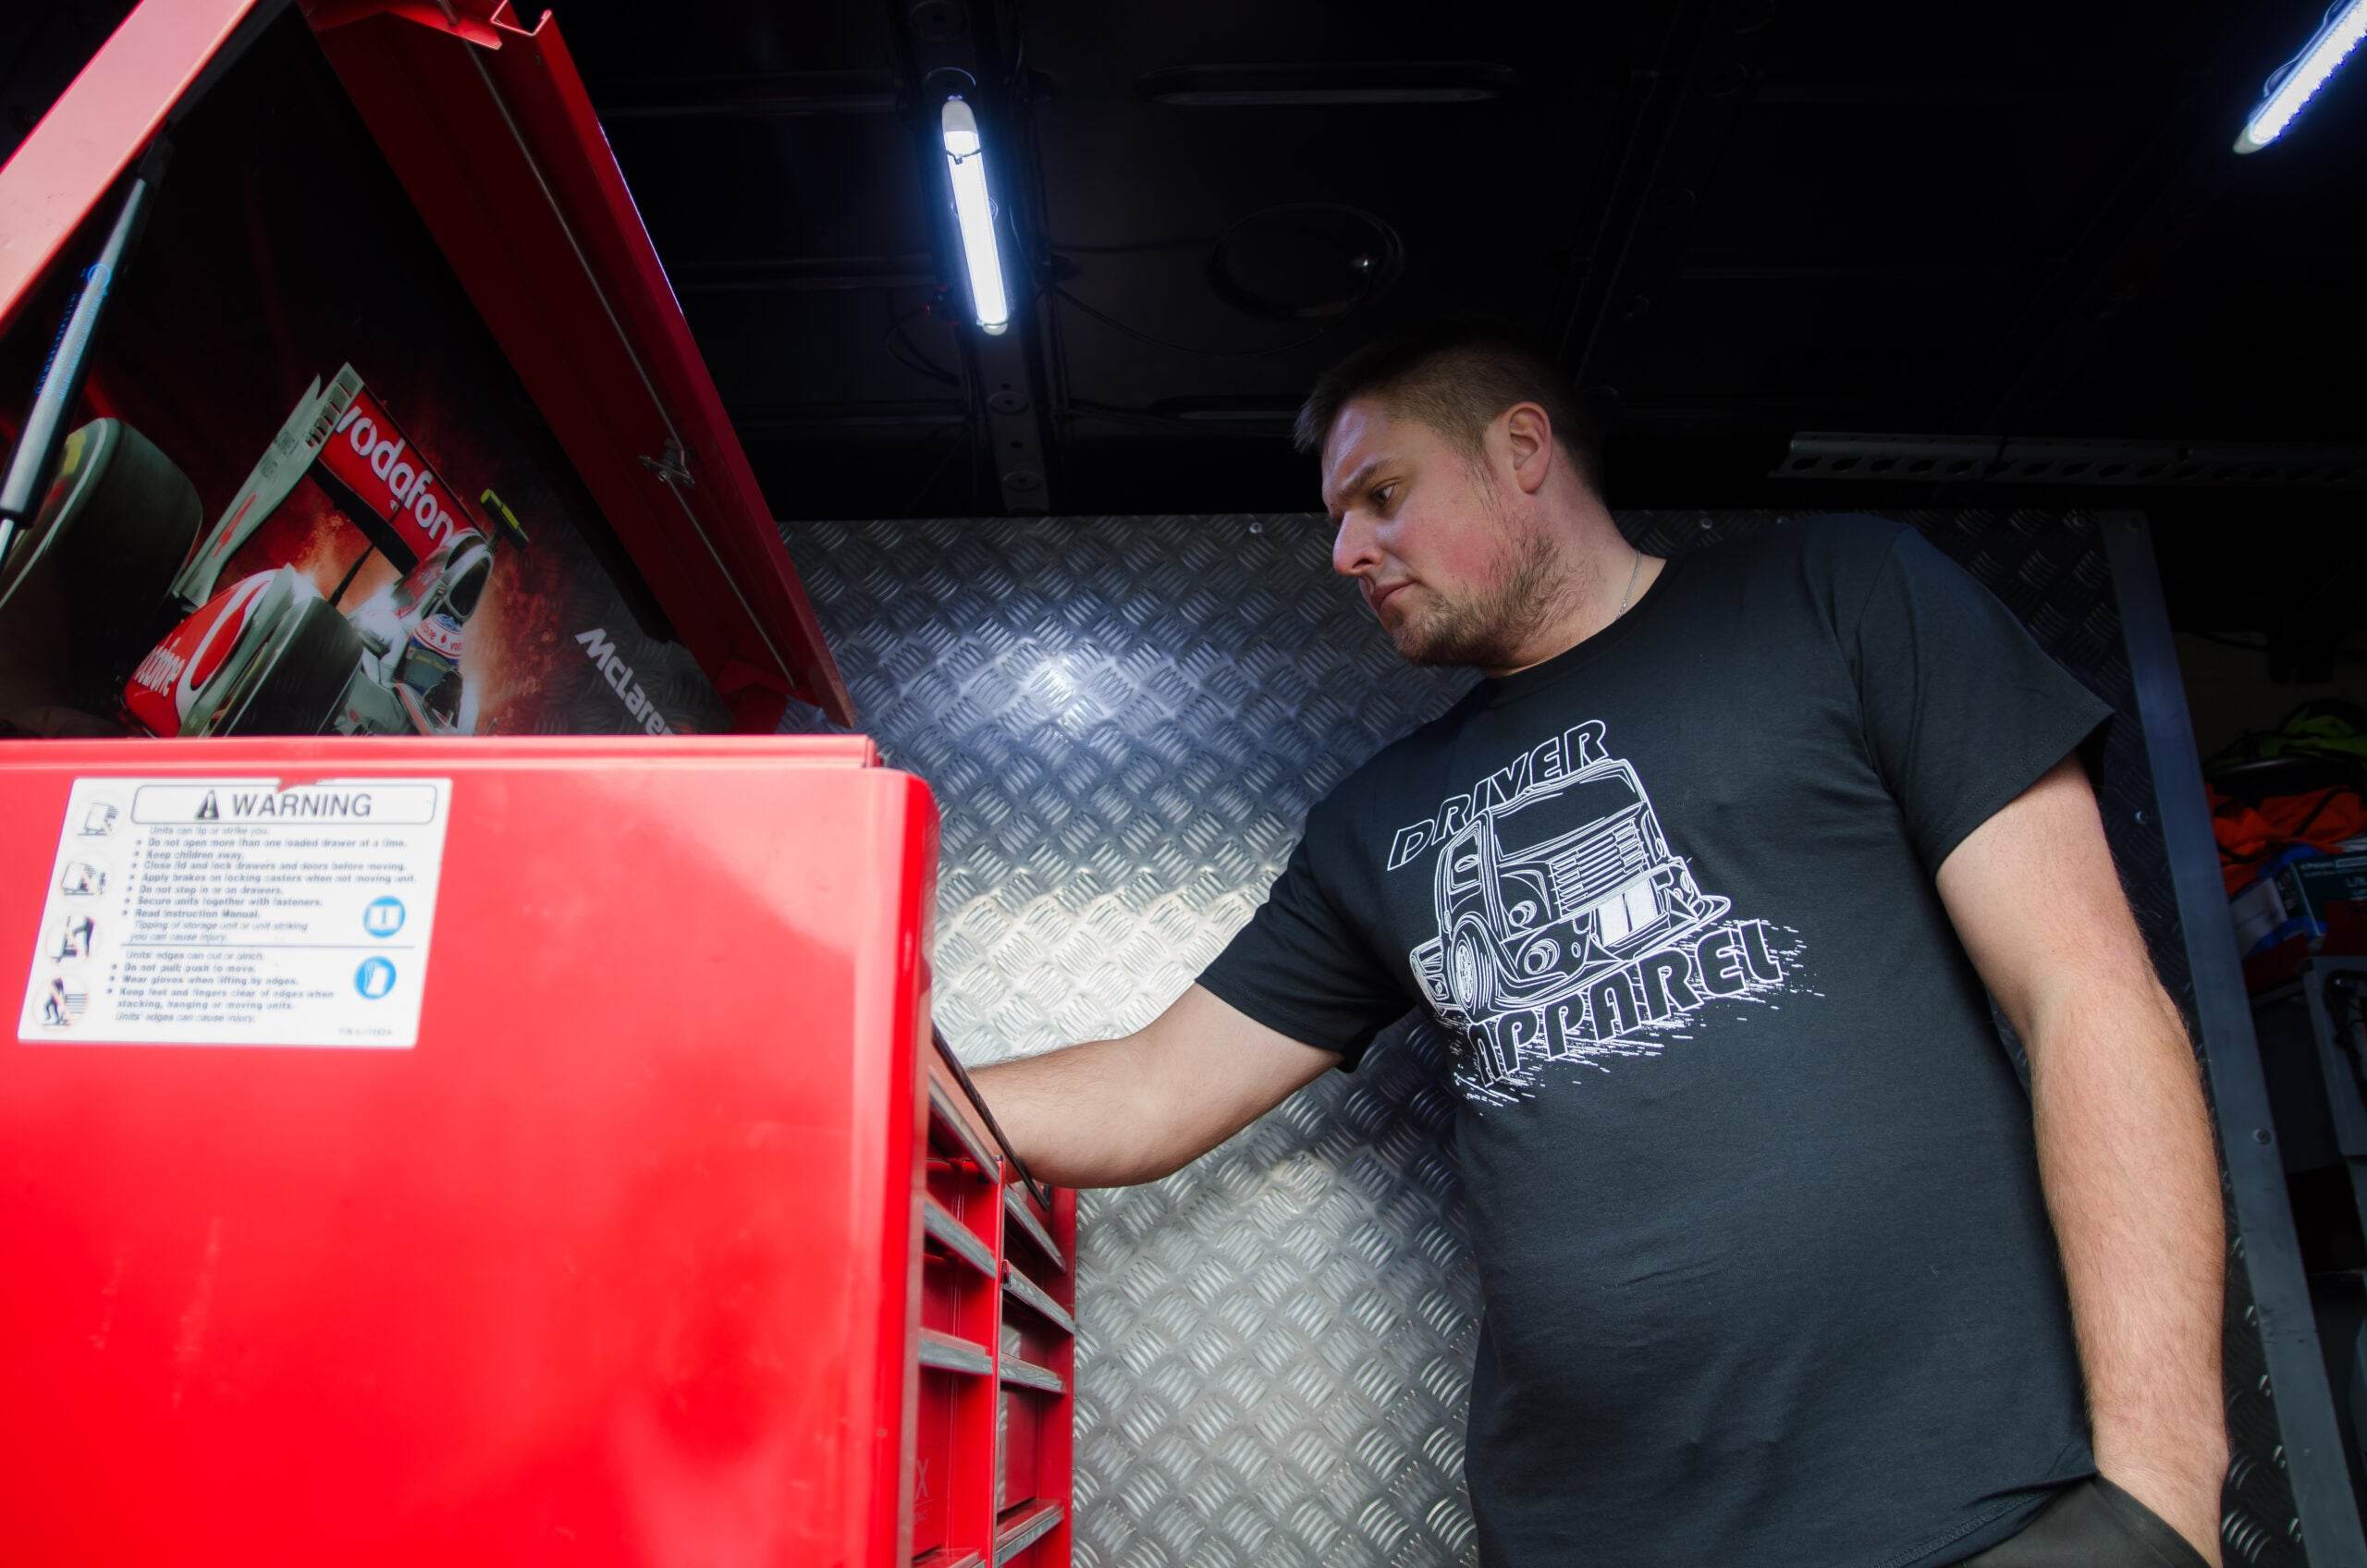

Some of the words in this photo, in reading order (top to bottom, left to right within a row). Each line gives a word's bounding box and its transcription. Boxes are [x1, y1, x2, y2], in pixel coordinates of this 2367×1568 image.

[336, 404, 454, 545] vodafon
[232, 792, 373, 817] WARNING
[1387, 719, 1609, 871] DRIVER
[1468, 918, 1784, 1089] APPAREL
